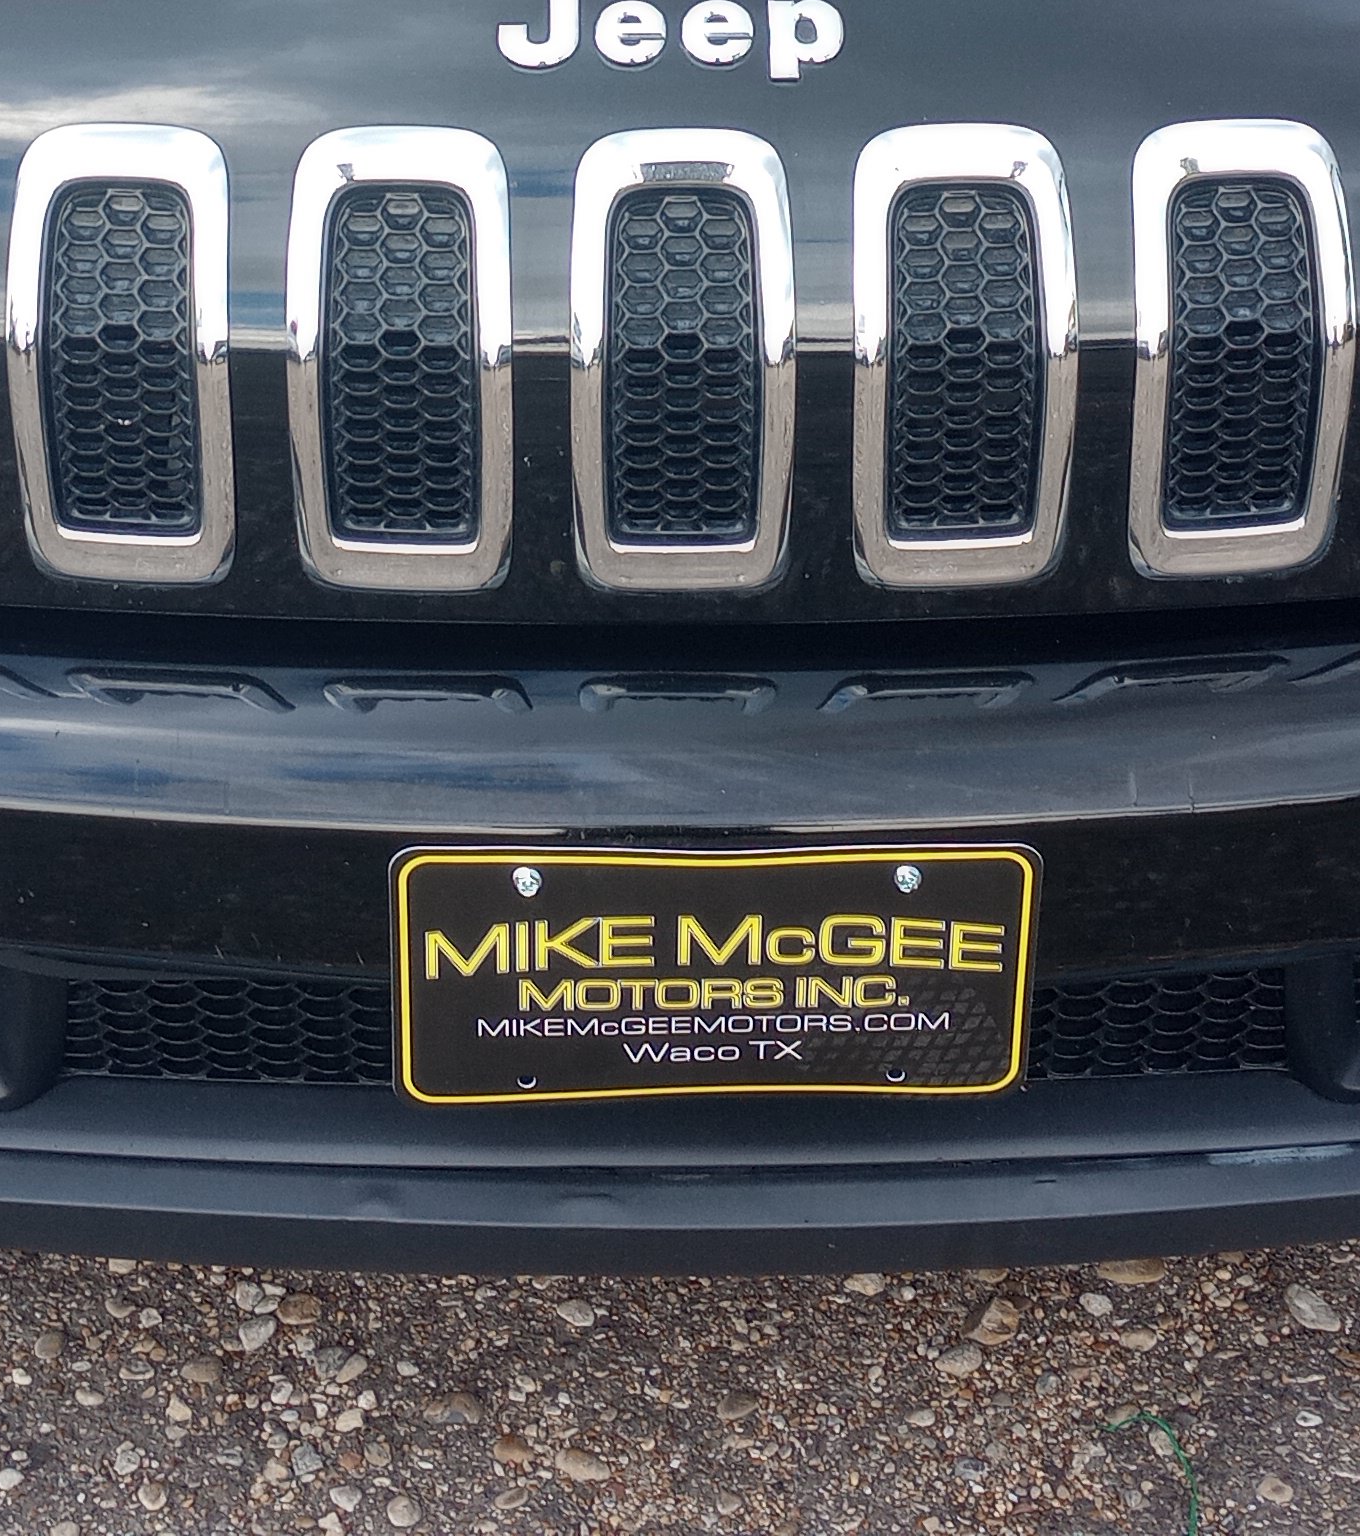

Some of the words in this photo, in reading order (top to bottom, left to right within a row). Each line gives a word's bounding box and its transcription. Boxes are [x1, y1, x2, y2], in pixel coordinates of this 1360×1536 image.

[425, 915, 655, 980] MIKE
[676, 913, 1006, 973] McGEE
[518, 976, 788, 1012] MOTORS
[795, 974, 912, 1009] INC.
[624, 1039, 743, 1064] Waco
[749, 1038, 804, 1062] TX
